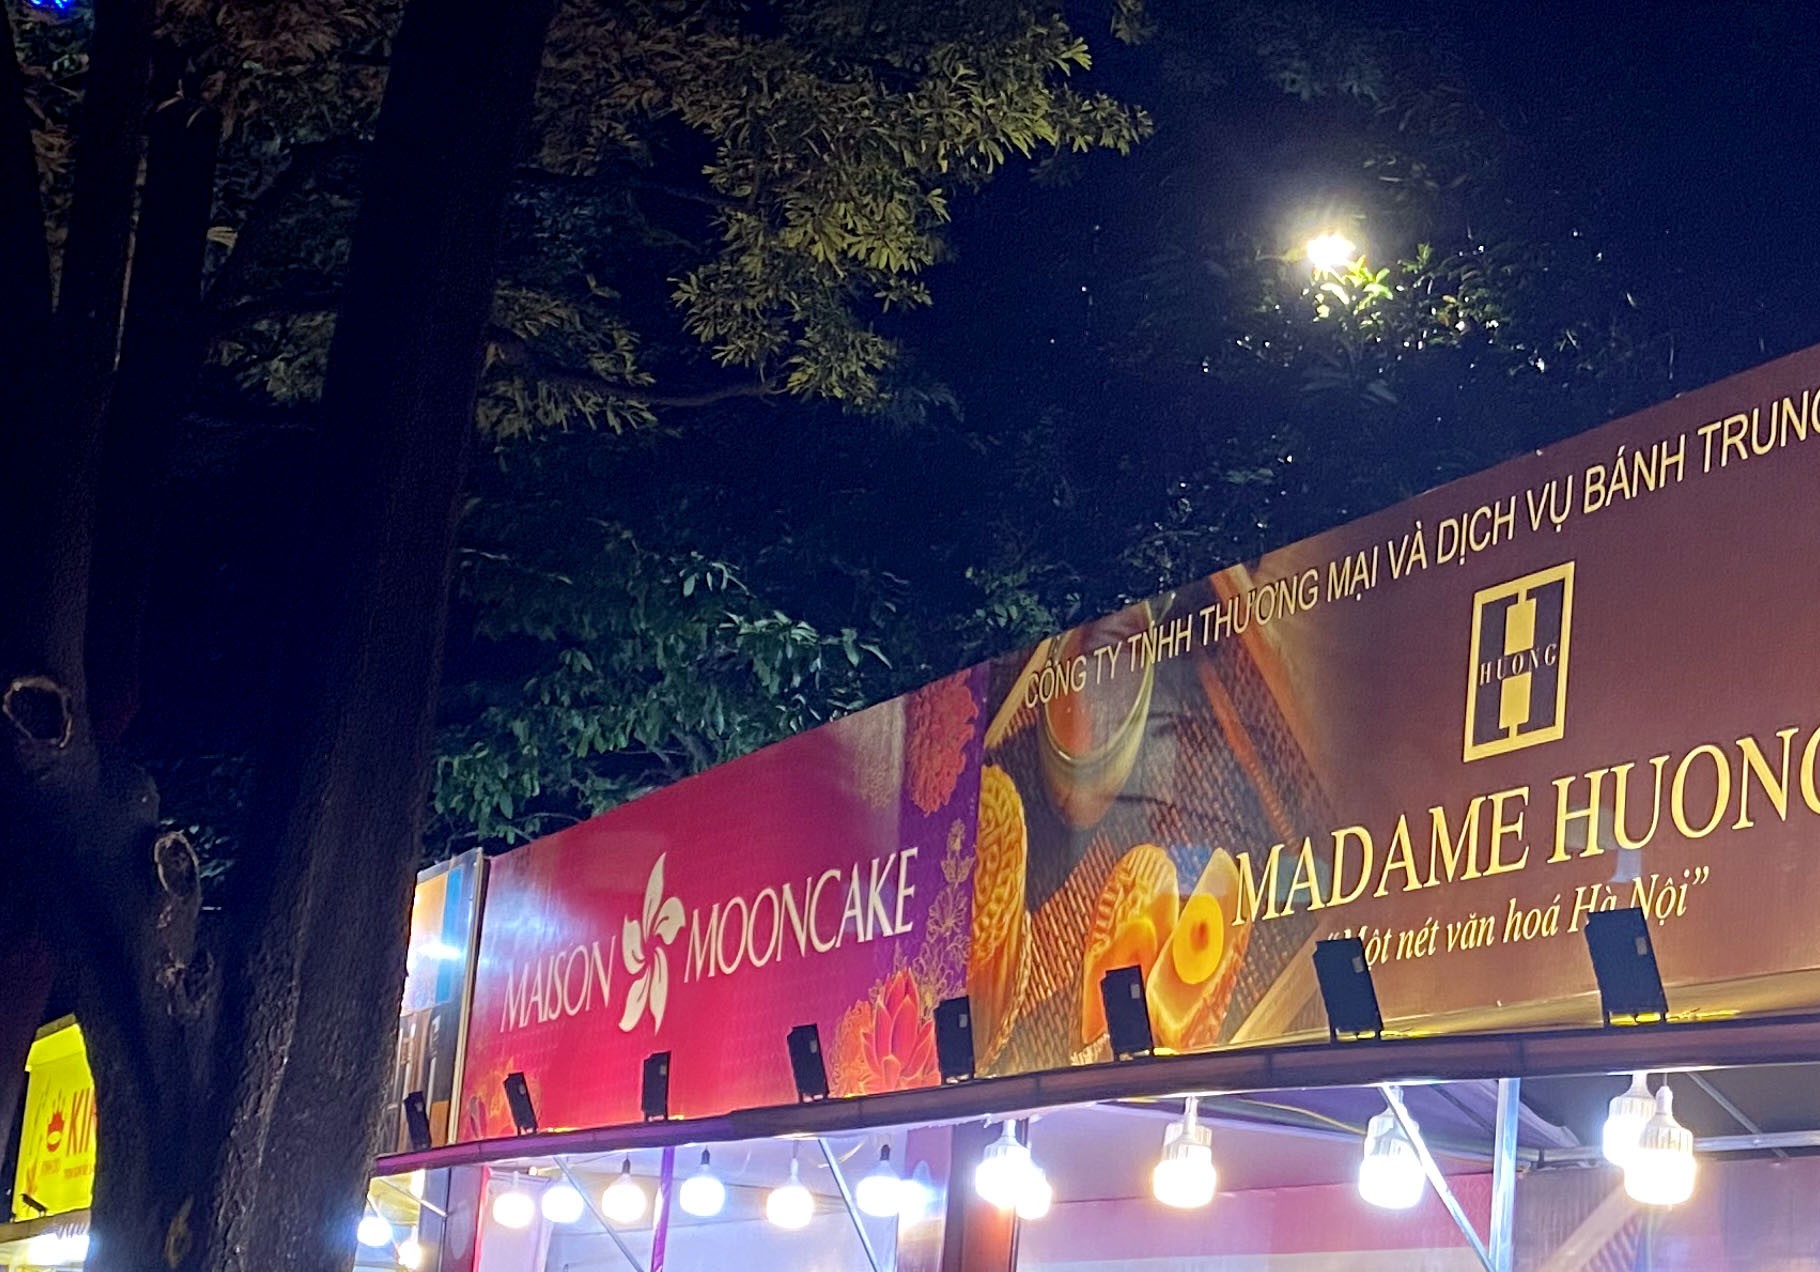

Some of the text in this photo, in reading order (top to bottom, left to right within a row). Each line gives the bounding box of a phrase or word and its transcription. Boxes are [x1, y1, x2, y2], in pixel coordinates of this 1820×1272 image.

[1022, 665, 1087, 708] CÔNG
[1092, 640, 1122, 685] TY
[1126, 612, 1193, 674] TNHH
[1199, 570, 1322, 646] THƯƠNG
[1326, 552, 1379, 603] MẠI
[1386, 520, 1430, 581] VÀ
[1435, 496, 1516, 569] DỊCH
[1524, 481, 1573, 534] VỤ
[1582, 433, 1687, 514] BÁNH
[1477, 641, 1559, 688] HUONG
[1230, 785, 1530, 926] MADAME
[501, 846, 919, 1034] MAISON MOONCAKE
[1398, 914, 1439, 960] nét
[1446, 907, 1497, 954] văn
[1503, 893, 1561, 944] hoá
